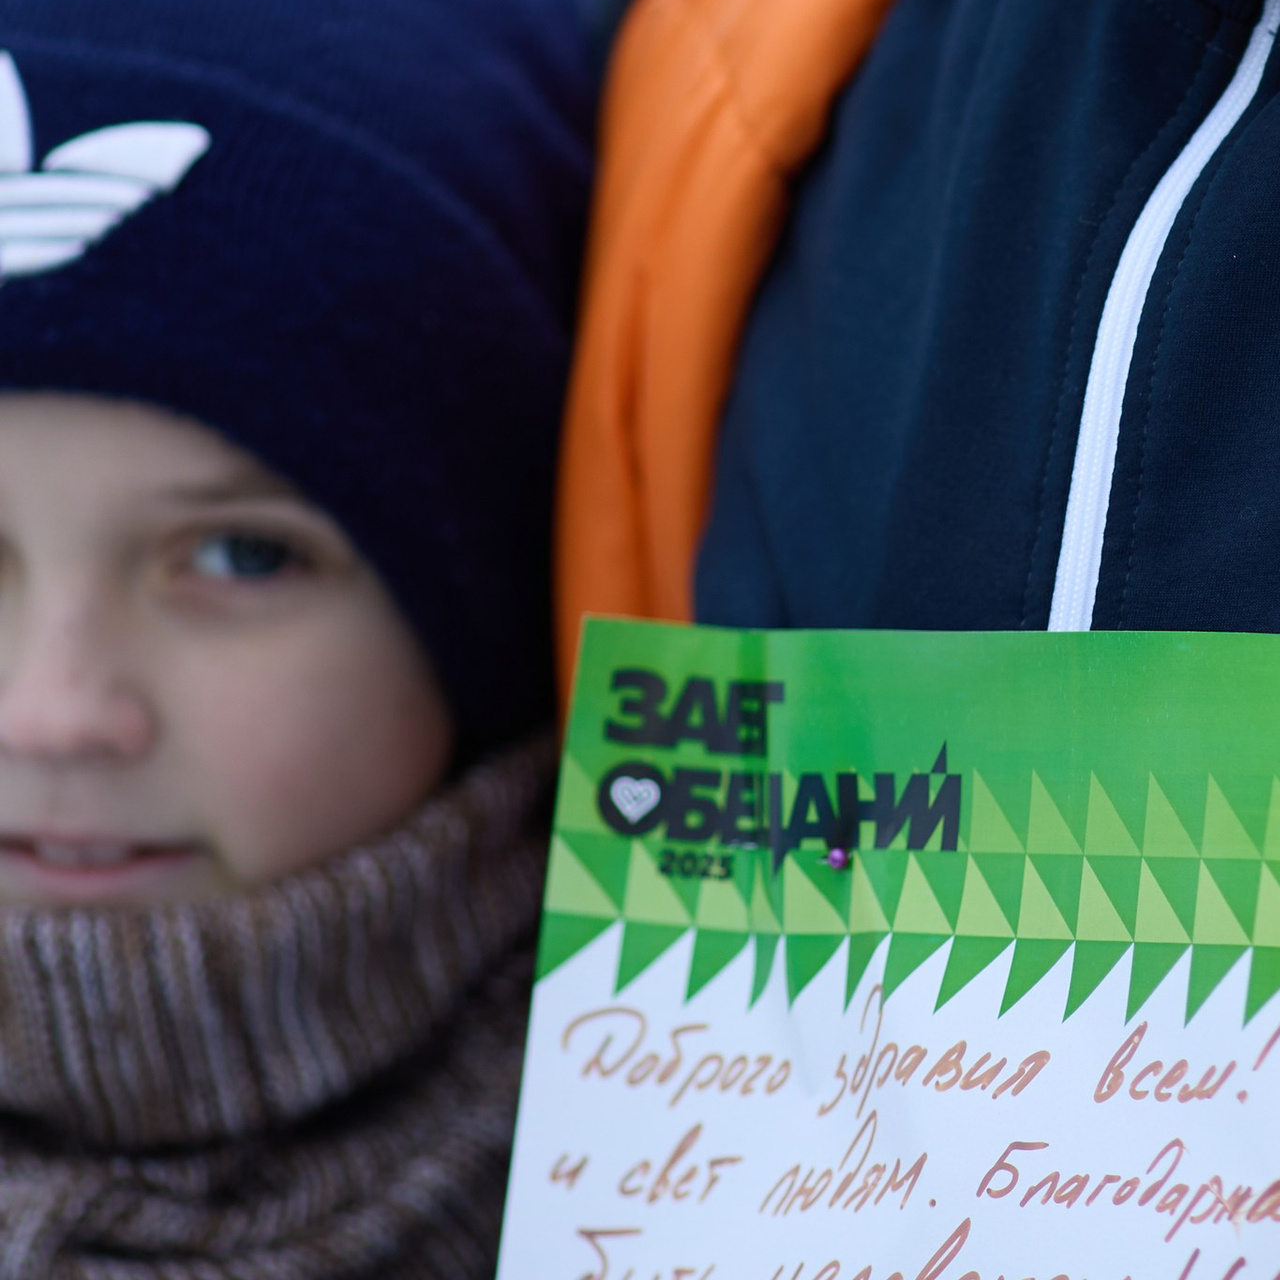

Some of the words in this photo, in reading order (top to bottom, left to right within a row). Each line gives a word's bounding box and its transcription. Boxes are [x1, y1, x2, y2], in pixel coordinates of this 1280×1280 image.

[560, 1006, 794, 1110] Доброго
[548, 1153, 589, 1190] и
[617, 1121, 743, 1206] свет
